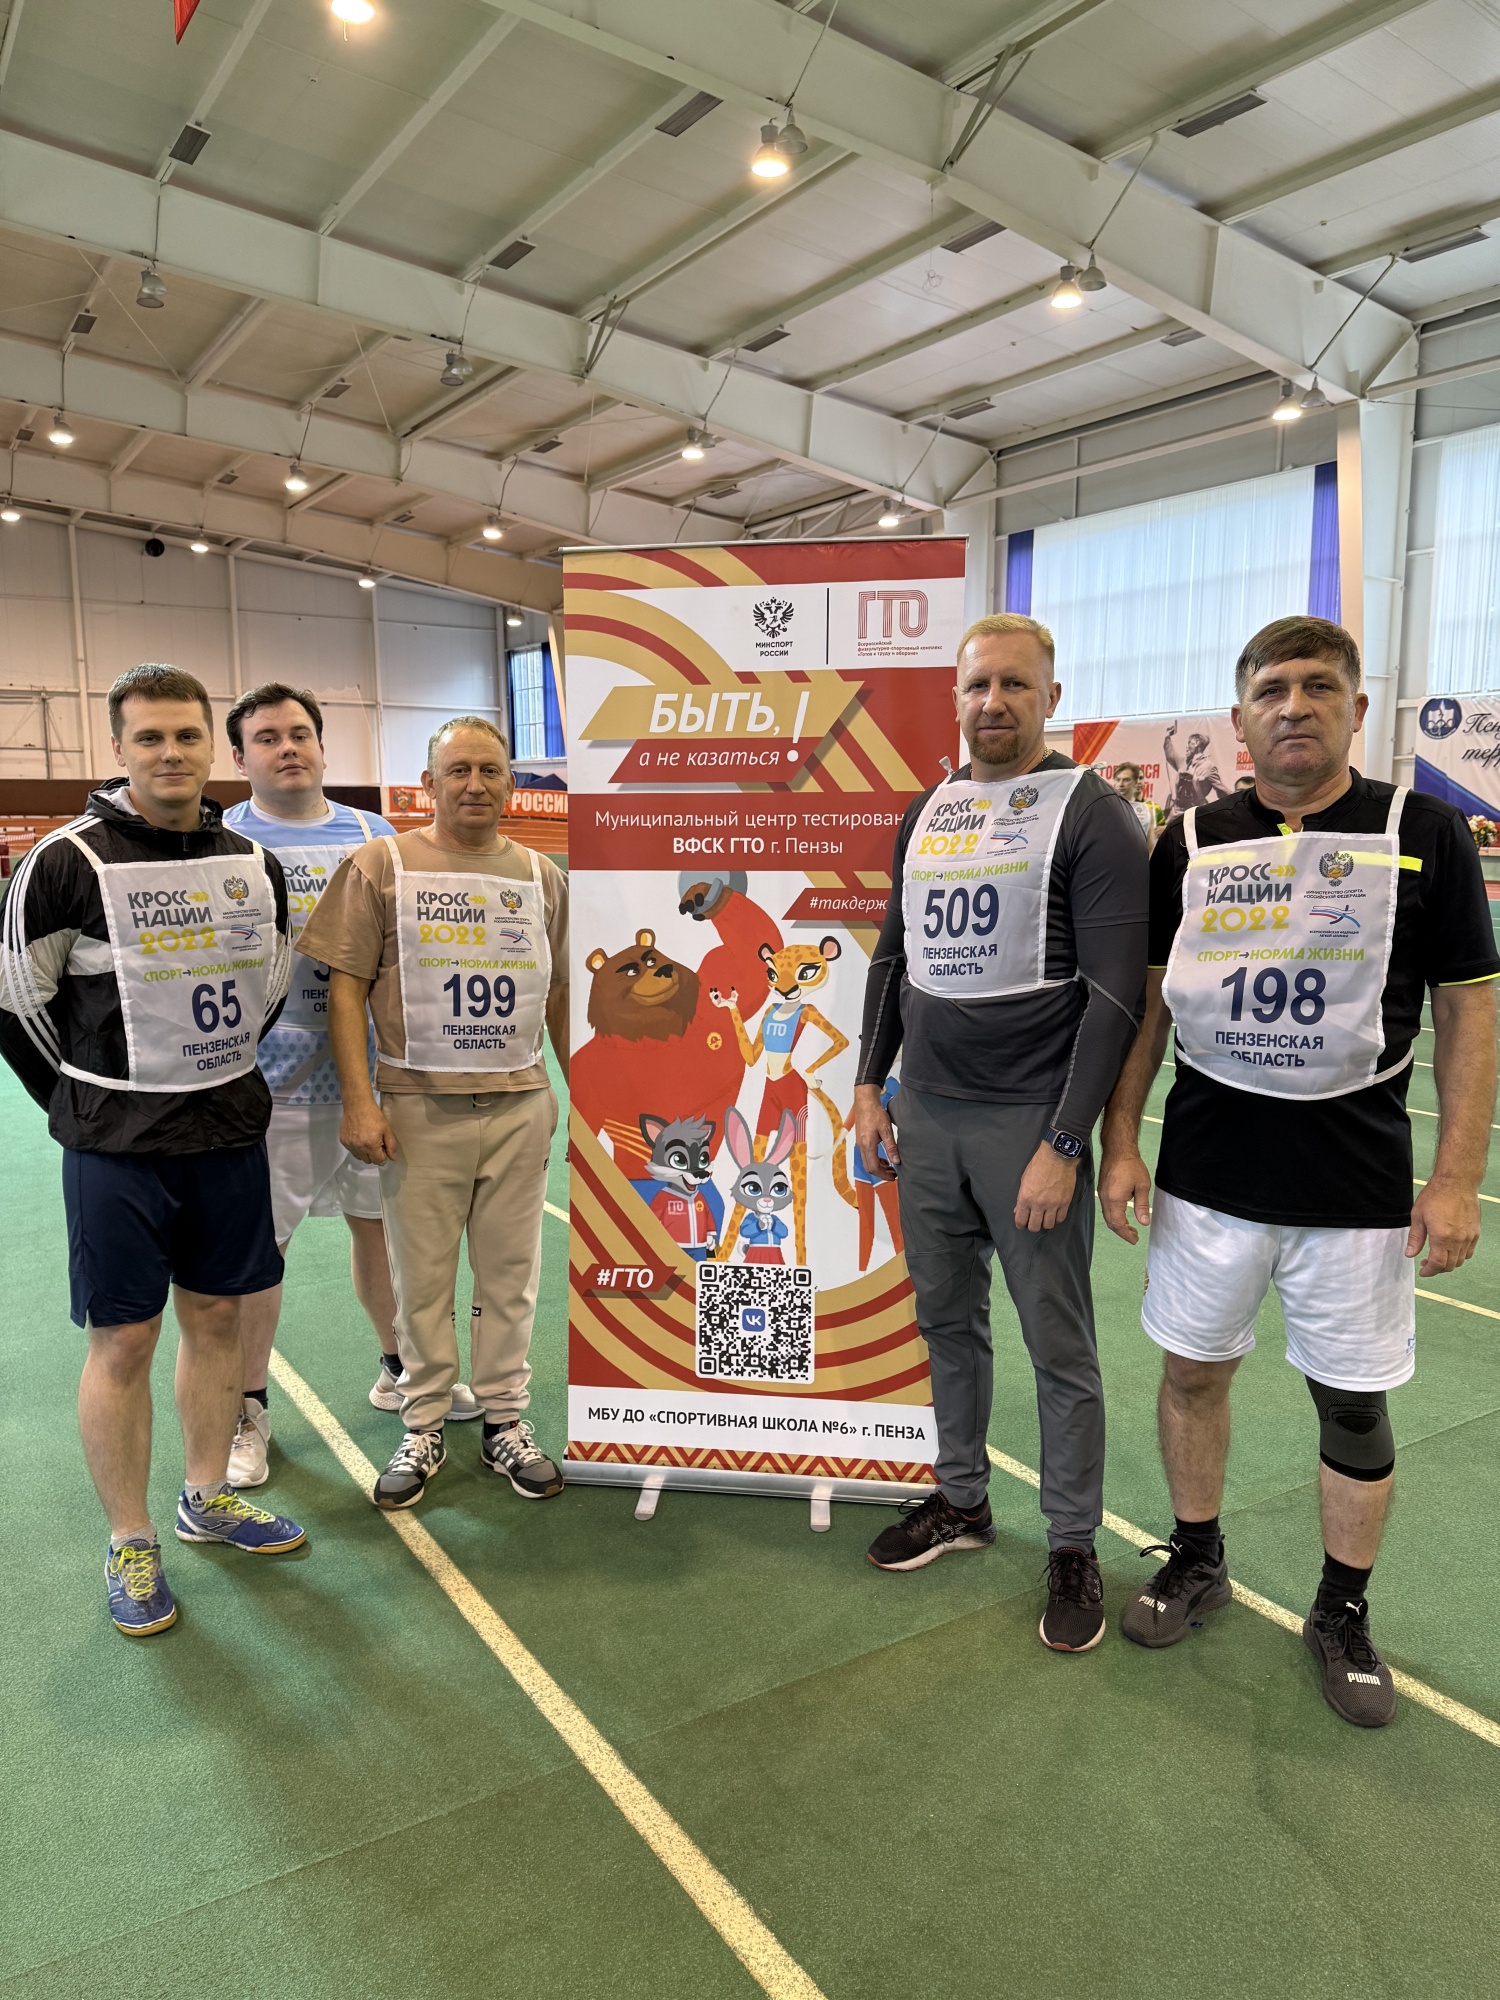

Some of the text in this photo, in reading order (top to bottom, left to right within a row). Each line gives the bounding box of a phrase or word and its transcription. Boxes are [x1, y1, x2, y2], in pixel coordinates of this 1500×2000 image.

[858, 590, 929, 639] ГТО
[755, 640, 793, 649] МИНСПОРТ
[759, 649, 789, 657] РОССИИ
[649, 692, 780, 735] БЫТЬ,
[639, 751, 780, 766] а не казаться
[933, 798, 975, 817] КРОСС
[595, 810, 904, 830] Муниципальный центр тестирован
[925, 814, 987, 833] НАЦИИ
[673, 837, 843, 854] ВФСК ГТО г. Пензы
[917, 833, 979, 856] 2022
[283, 864, 312, 878] ОСС
[911, 860, 1029, 882] СПОРТ НОРМА ЖИЗНИ
[1208, 862, 1272, 887] КРОСС
[287, 878, 328, 894] ЦИИ
[1205, 883, 1293, 906] НАЦИИ
[127, 889, 191, 910] КРОСС
[289, 895, 318, 913] 02
[417, 891, 470, 907] КРОСС
[810, 895, 888, 913] #такдерж
[132, 906, 213, 929] НАЦИИ
[417, 906, 486, 924] НАЦИИ
[923, 883, 1000, 939] 509
[1200, 905, 1290, 933] 2022
[139, 926, 218, 956] 2022
[419, 924, 486, 946] 2022
[922, 943, 998, 960] ПЕНЗЕНСКАЯ
[1197, 947, 1365, 962] СПОРТ НОРМА ЖИЗНИ
[143, 967, 183, 983] СПОРТ
[232, 957, 265, 972] ЖИЗНИ
[419, 957, 537, 970] СПОРТ НОРМА ЖИЗНИ
[929, 962, 984, 977] ОБЛАСТЬ
[443, 973, 516, 1018] 199
[1221, 966, 1327, 1026] 198
[192, 979, 242, 1033] 65
[442, 1024, 516, 1036] ПЕНЗЕНСКАЯ
[766, 1022, 787, 1037] ГТО
[182, 1031, 250, 1058] ПЕНЗЕНСКАЯ
[453, 1038, 506, 1050] ОБЛАСТЬ
[1215, 1030, 1324, 1050] ПЕНЗЕНСКАЯ
[196, 1050, 242, 1071] ОБЛАСТЬ
[1230, 1050, 1306, 1067] ОБЛАСТЬ
[596, 1267, 654, 1289] #ГТО
[745, 1314, 762, 1326] VK
[588, 1407, 926, 1441] МБУ ДО «СПОРТИВНАЯ ШКОЛА №6» г. ПЕНЗА
[1346, 1672, 1381, 1686] PUMA
